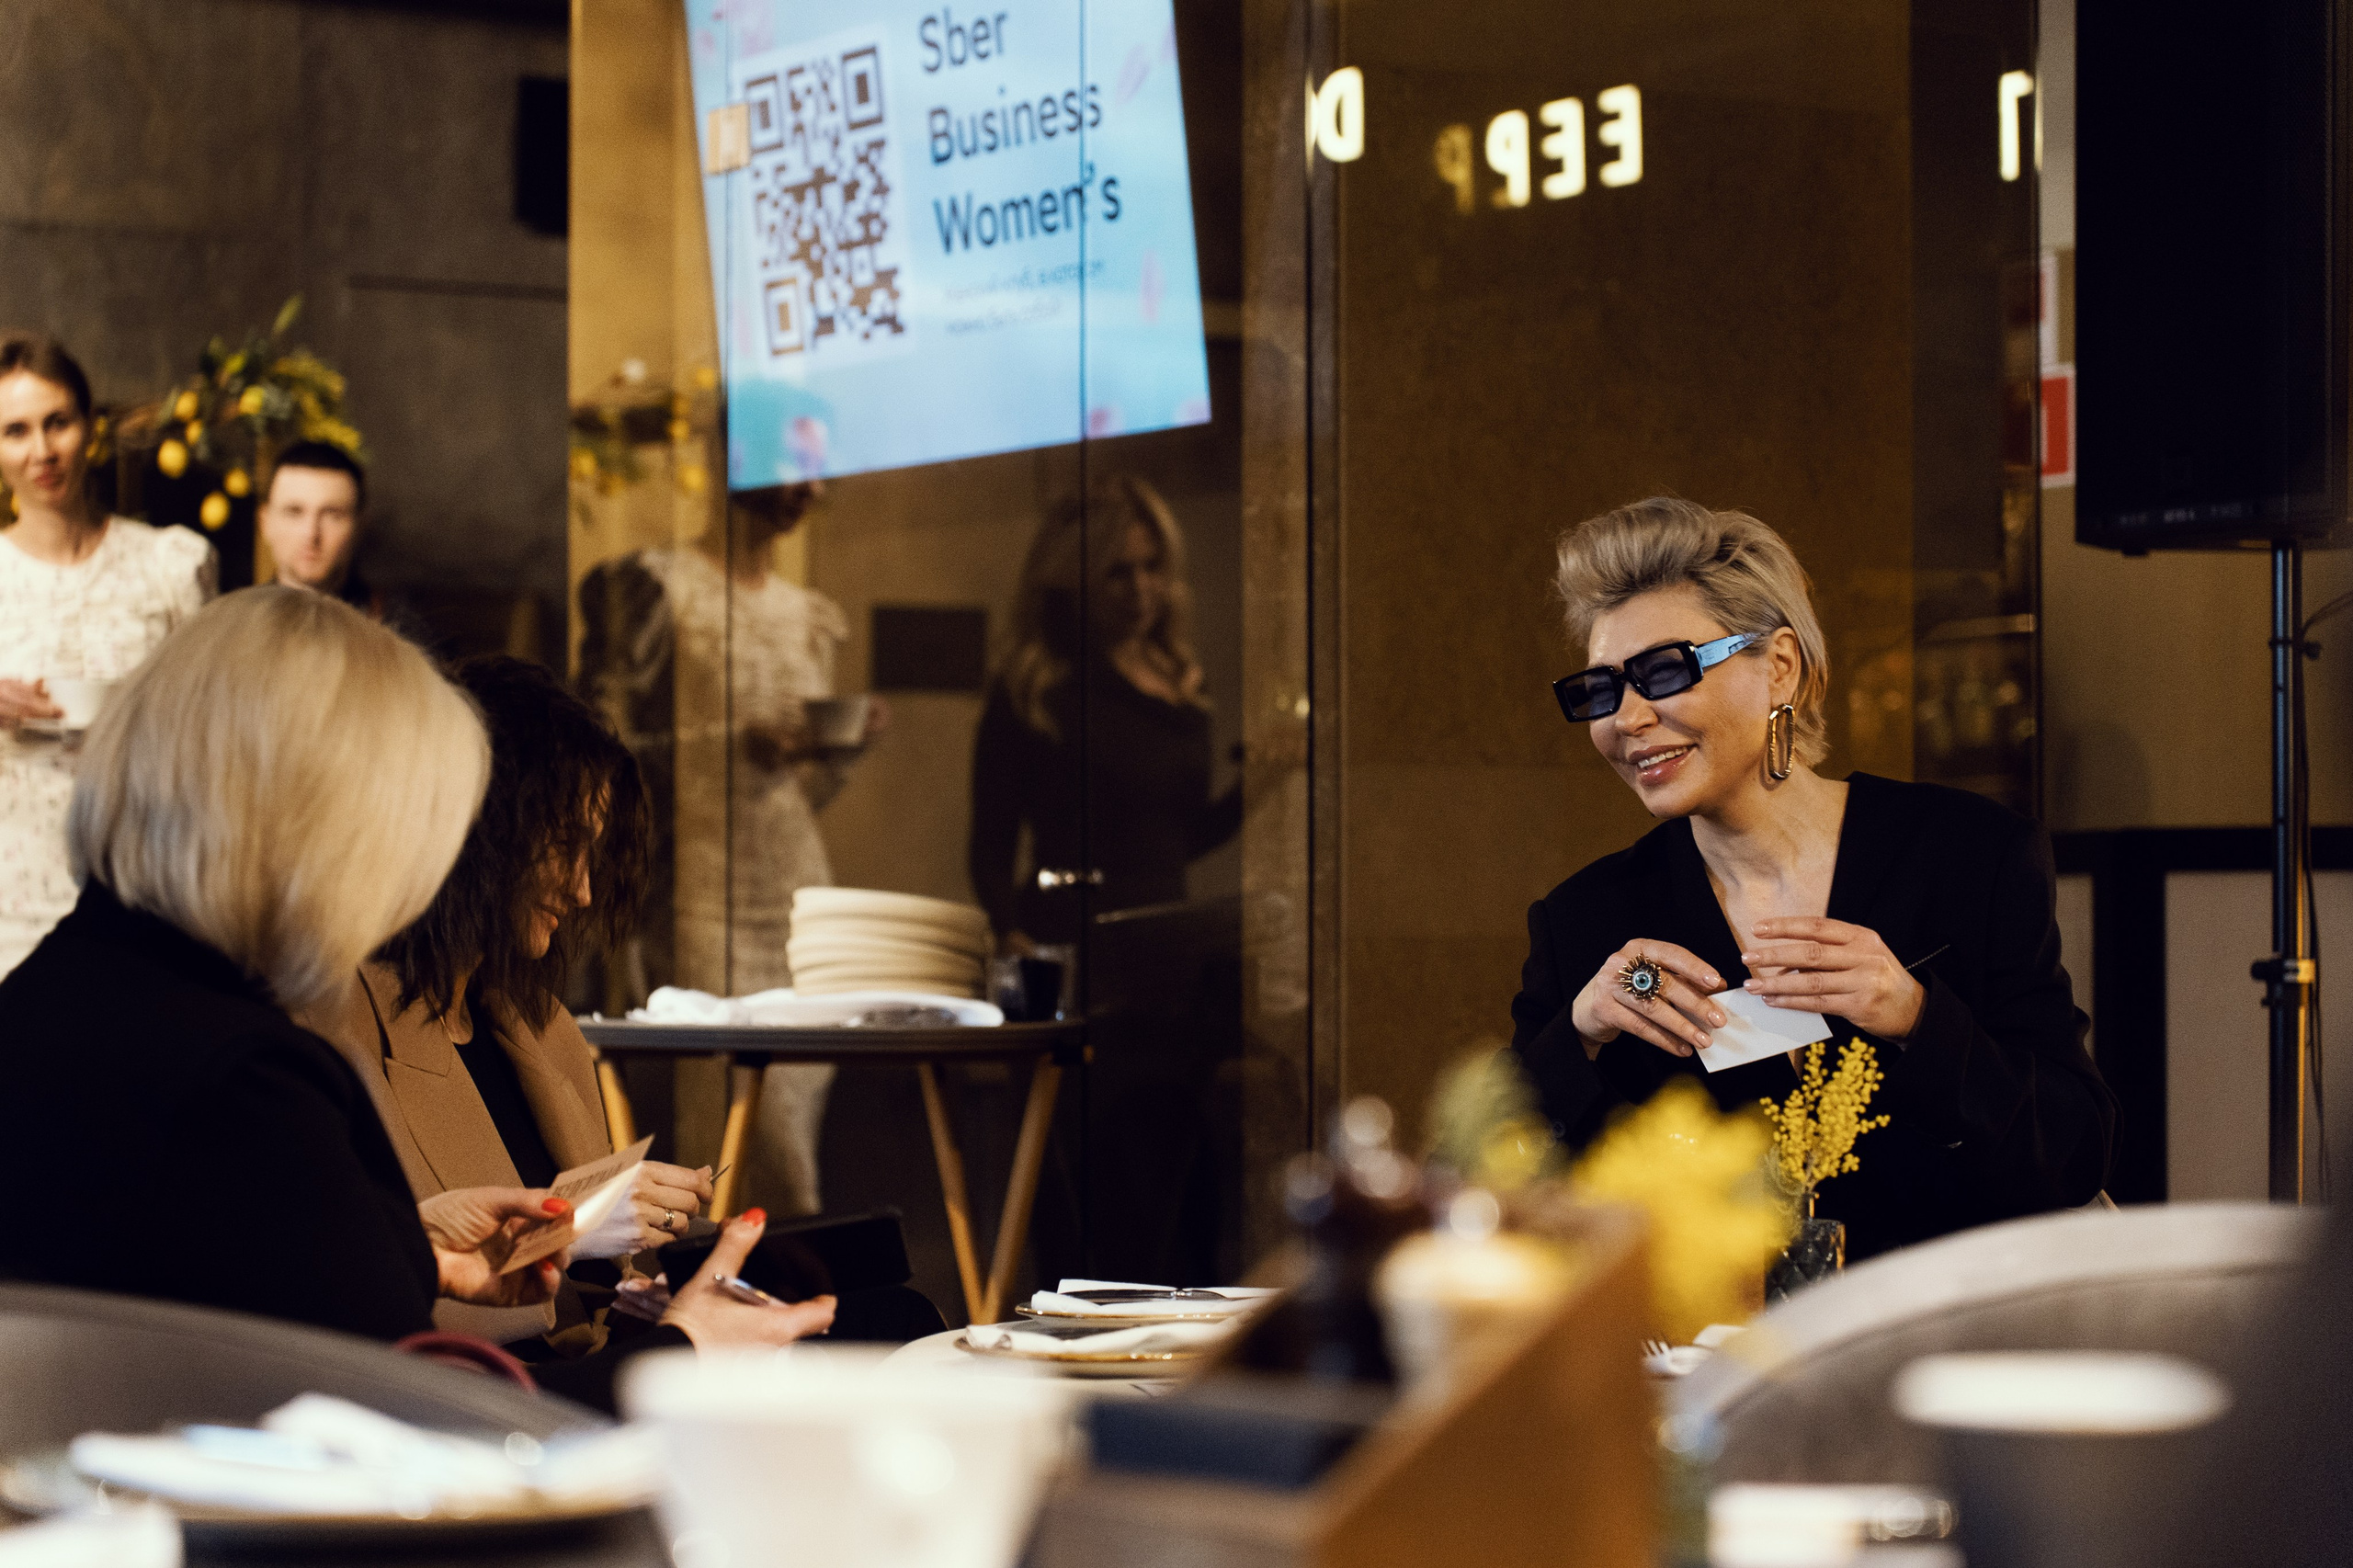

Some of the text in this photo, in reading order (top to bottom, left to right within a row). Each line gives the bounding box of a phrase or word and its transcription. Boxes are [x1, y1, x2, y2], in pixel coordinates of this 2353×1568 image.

[918, 6, 1008, 74] Sber
[928, 82, 1102, 166] Business
[933, 160, 1122, 255] Women's
